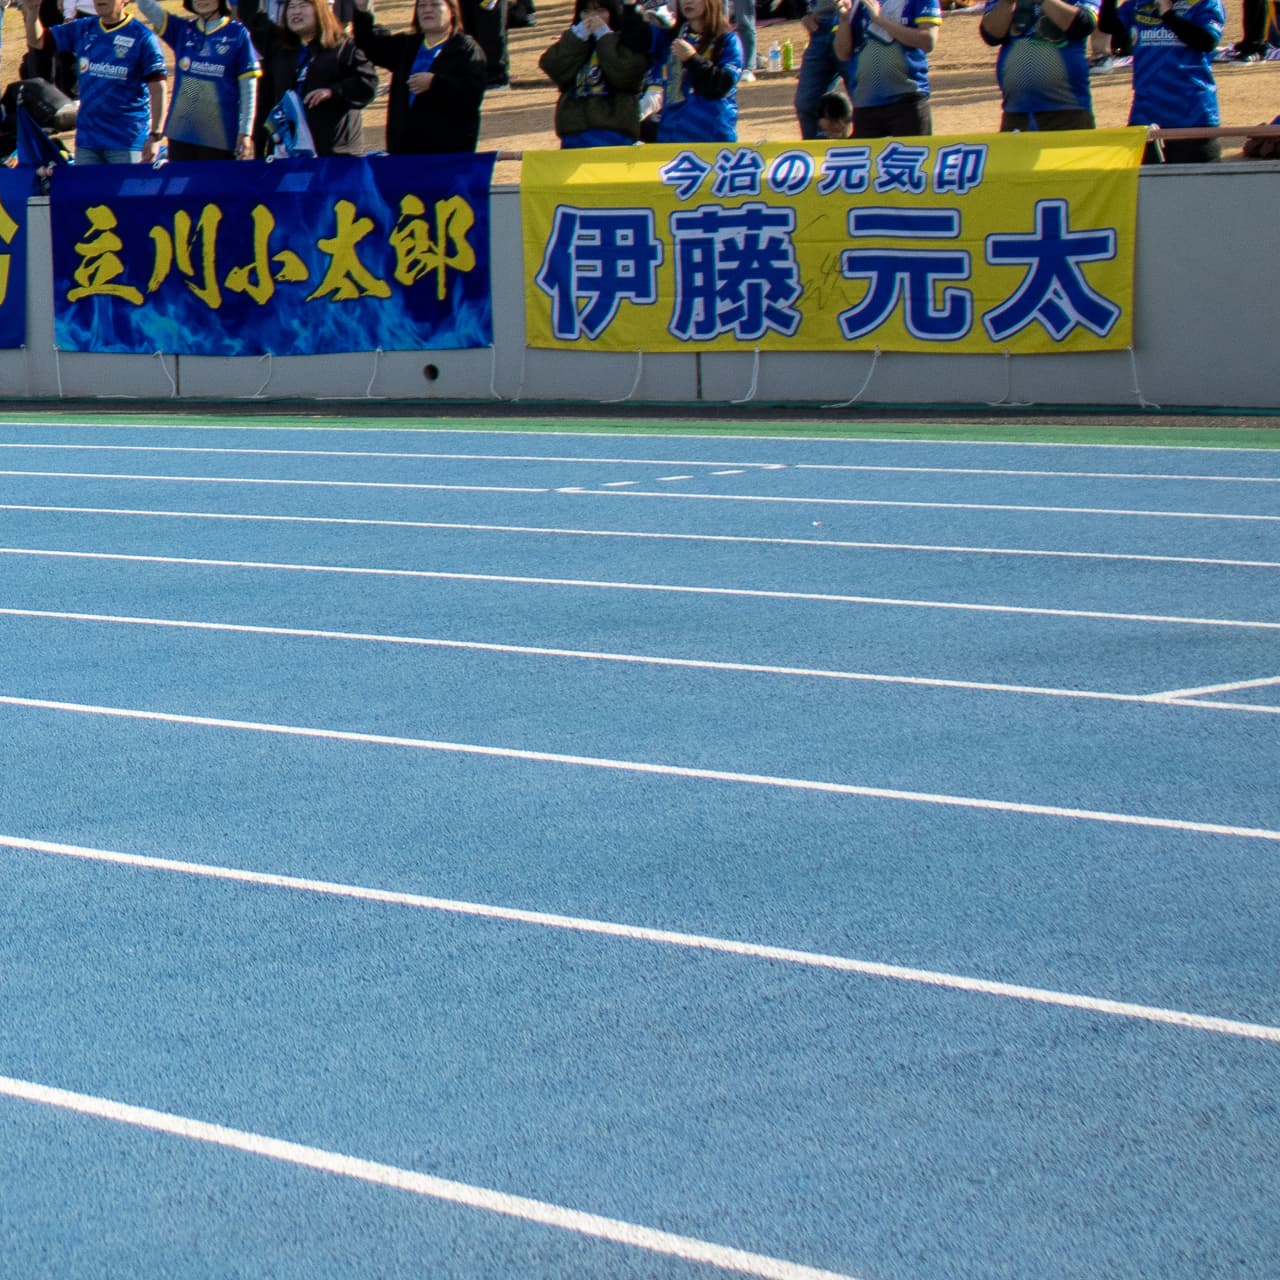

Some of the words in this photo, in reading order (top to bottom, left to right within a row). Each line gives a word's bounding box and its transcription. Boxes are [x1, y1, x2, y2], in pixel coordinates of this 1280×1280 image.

[88, 61, 129, 76] unicharm
[658, 141, 989, 201] 今治の元気印
[66, 194, 476, 310] 立川小太郎
[536, 201, 803, 342] 伊藤
[838, 198, 1123, 343] 元太
